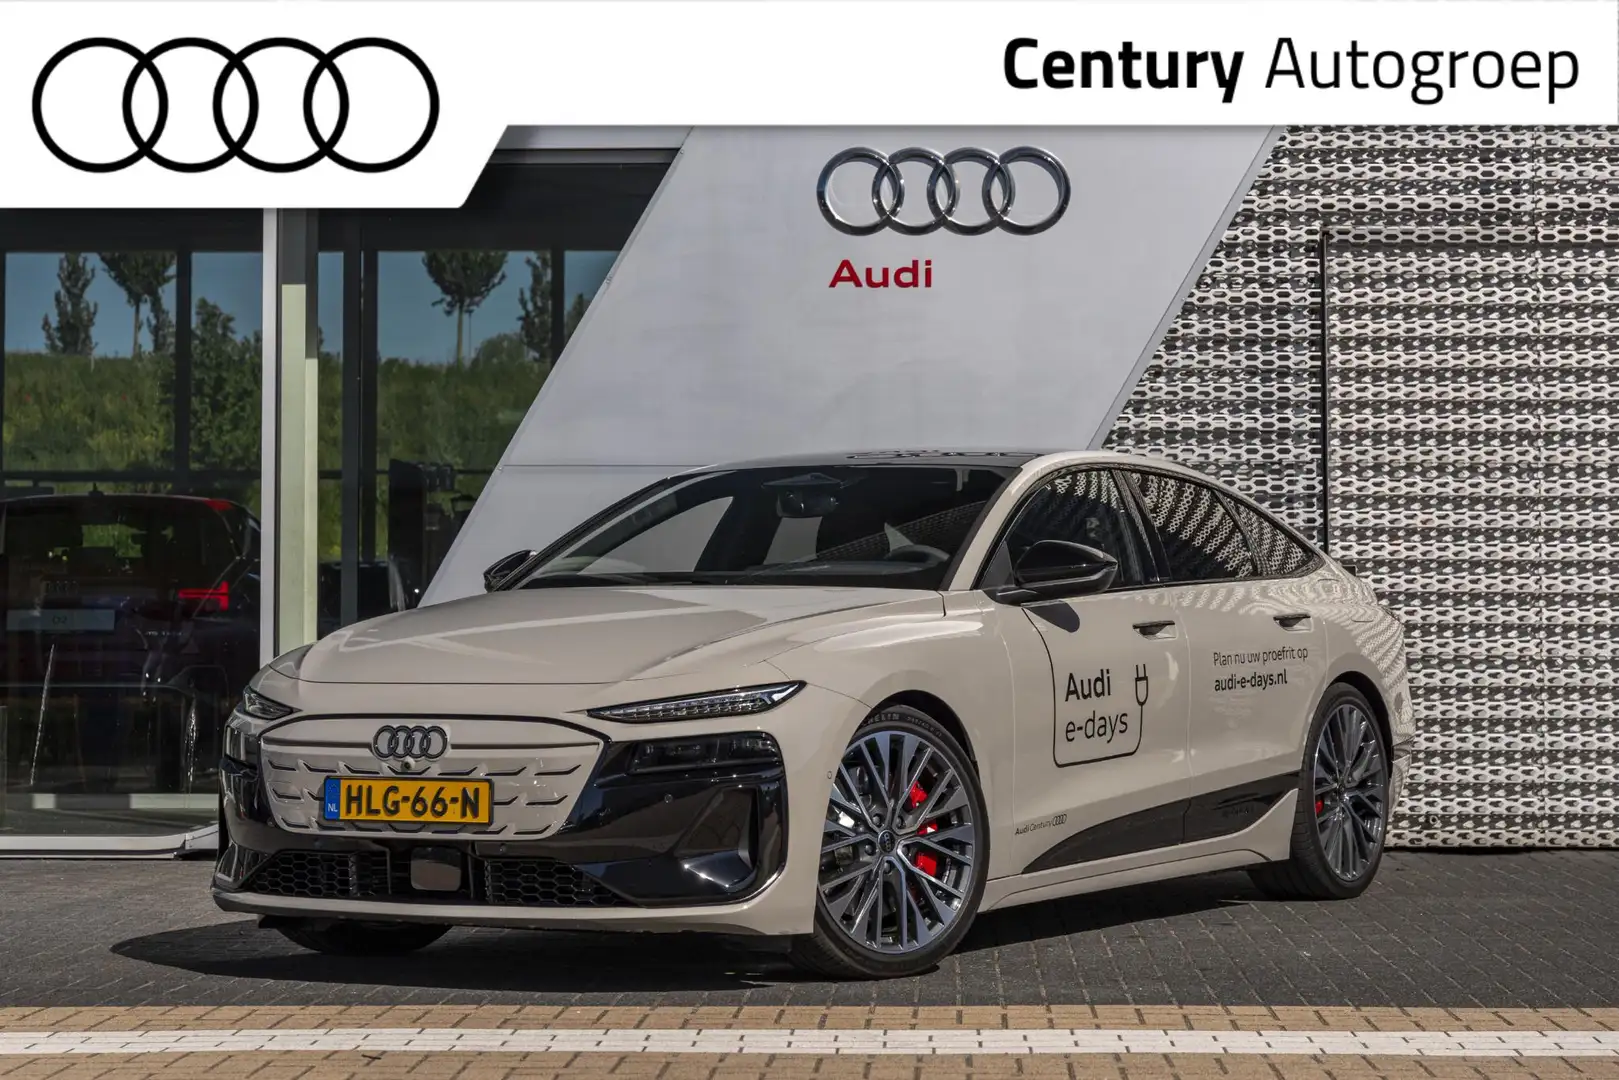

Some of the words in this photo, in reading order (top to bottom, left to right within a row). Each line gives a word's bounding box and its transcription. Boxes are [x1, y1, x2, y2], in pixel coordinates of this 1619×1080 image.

[828, 259, 932, 289] Audi
[1213, 652, 1233, 666] Plan
[1234, 653, 1246, 665] nu
[1247, 652, 1261, 664] uw
[1262, 646, 1296, 665] proefrit
[1297, 648, 1309, 662] op
[1064, 668, 1112, 702] Audi
[1214, 668, 1288, 692] audi-e-days.nl
[1065, 709, 1129, 744] e-days
[327, 803, 339, 813] NL
[345, 784, 480, 819] HLG-66-N
[1014, 823, 1030, 836] Audi
